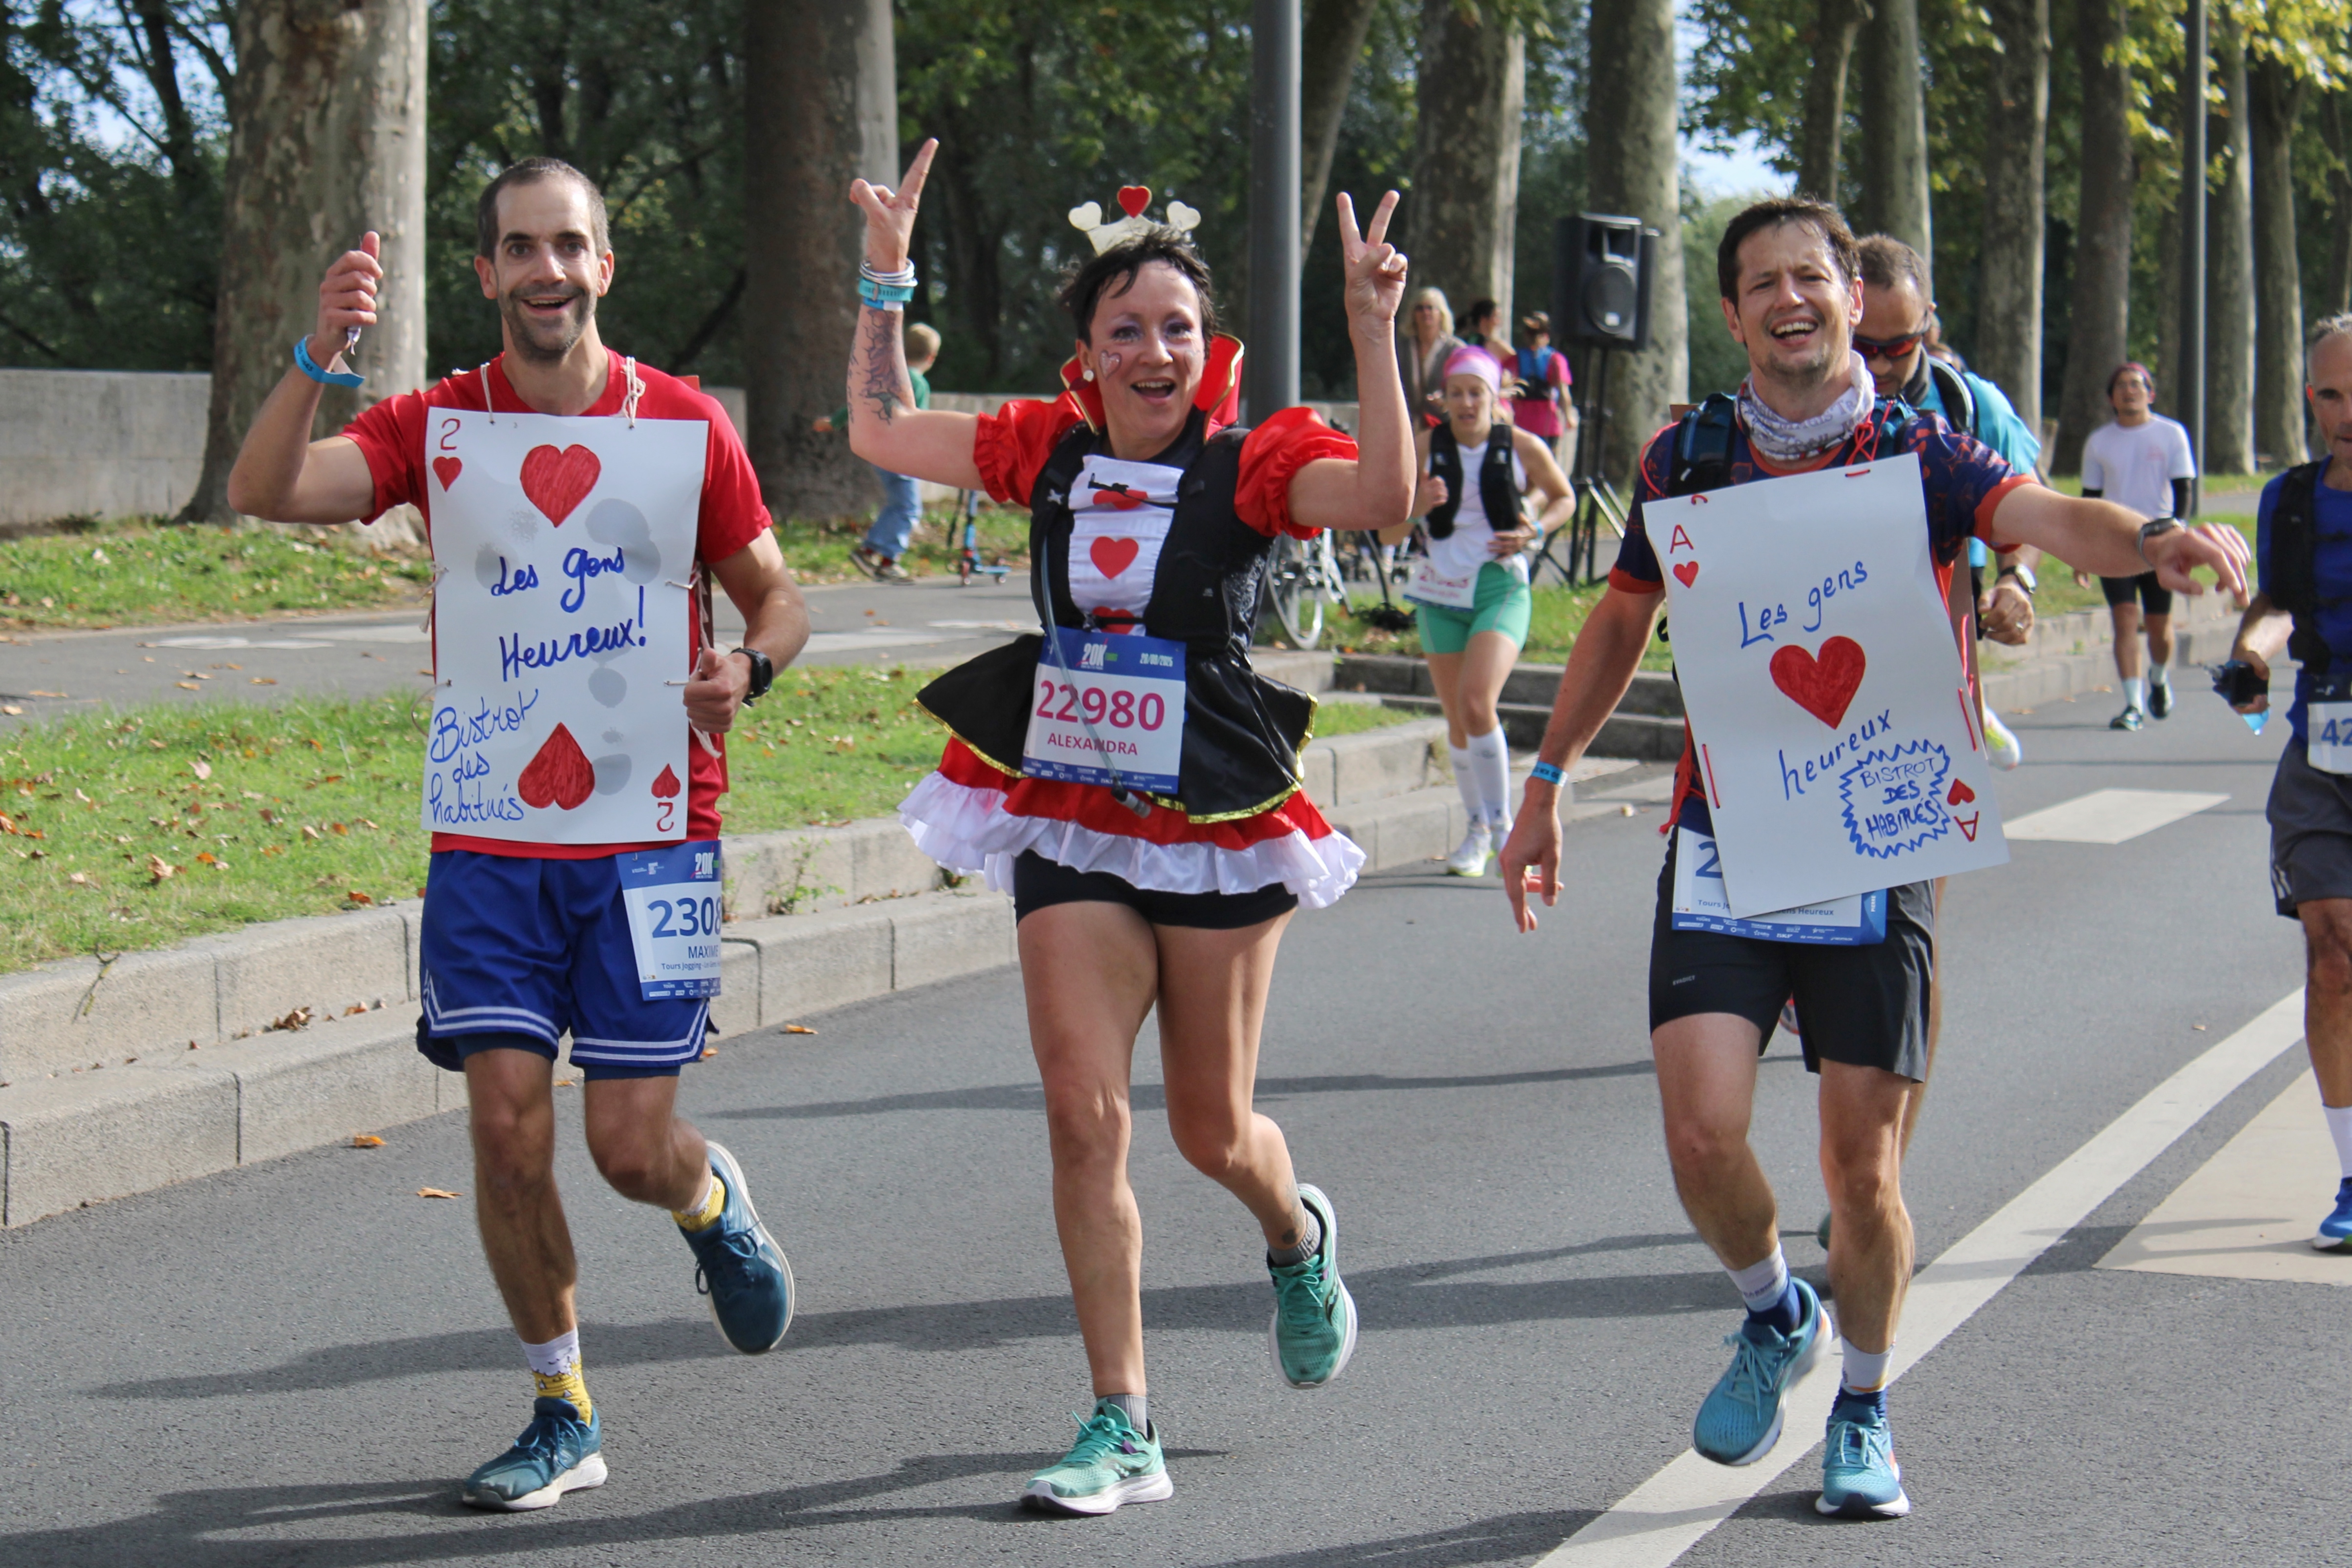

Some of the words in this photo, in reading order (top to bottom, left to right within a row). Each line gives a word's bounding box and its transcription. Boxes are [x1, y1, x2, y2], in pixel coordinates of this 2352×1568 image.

[440, 418, 461, 450] 2
[1670, 524, 1693, 554] A
[491, 557, 539, 596] Les
[561, 546, 625, 613] gens
[1739, 601, 1788, 649] Les
[1803, 561, 1868, 633] gens
[499, 586, 647, 681] Heureux!
[1081, 643, 1107, 666] 20K
[1036, 680, 1165, 731] 22980
[430, 688, 539, 763] Bistrot
[1047, 732, 1138, 756] ALEXANDRA
[1779, 709, 1893, 800] heureux
[453, 751, 490, 783] des
[1860, 757, 1935, 788] BISTROT
[428, 773, 524, 825] habitués
[1882, 780, 1920, 804] DES
[657, 802, 674, 832] 2
[1954, 811, 1979, 842] A
[695, 852, 714, 875] 20K
[1798, 907, 1834, 916] Heureux
[682, 962, 701, 971] Jogging
[688, 945, 718, 959] MAXIME
